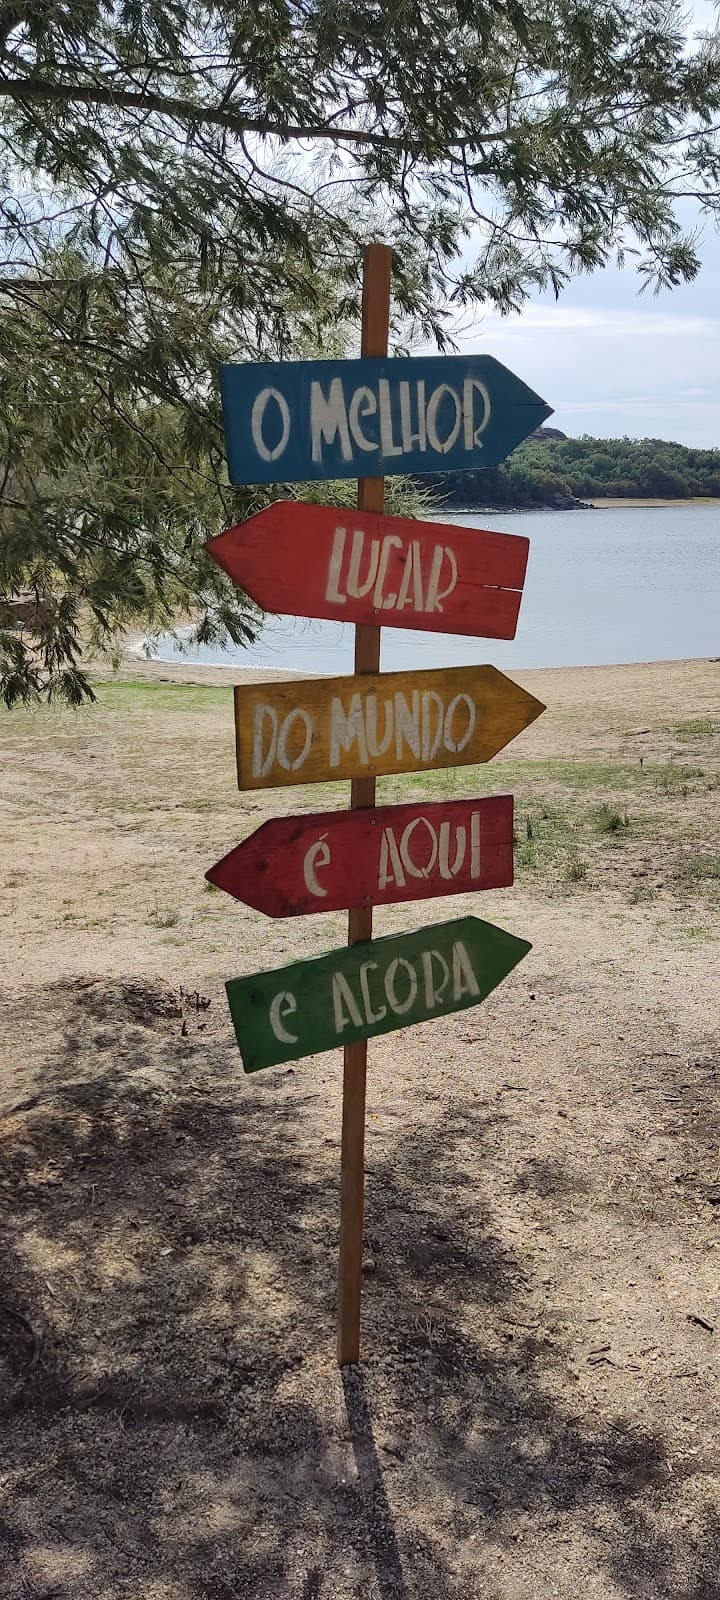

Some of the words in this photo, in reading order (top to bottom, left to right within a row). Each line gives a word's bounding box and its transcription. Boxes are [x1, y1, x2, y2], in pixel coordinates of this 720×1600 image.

[251, 387, 291, 462] O
[325, 527, 458, 613] LUGAR
[252, 703, 313, 778] DO
[329, 689, 476, 767] MUNDO
[303, 832, 331, 897] é
[378, 811, 481, 890] AQUI
[269, 991, 299, 1044] e
[332, 940, 481, 1034] AGORA
